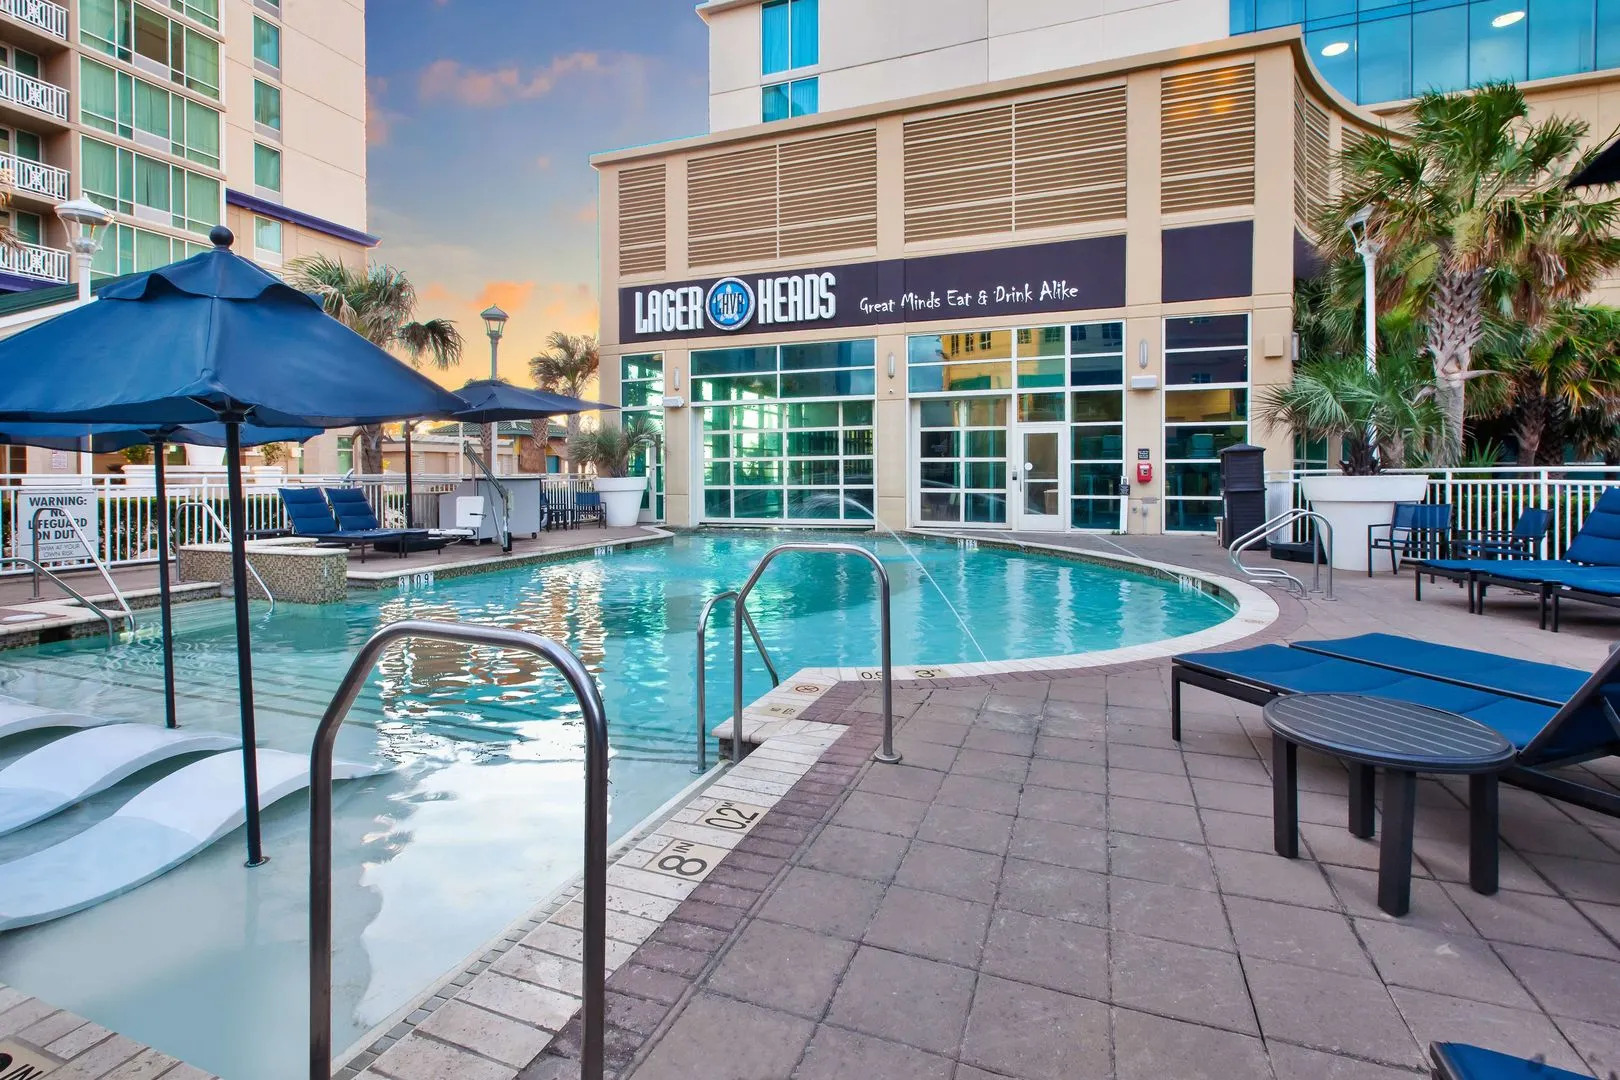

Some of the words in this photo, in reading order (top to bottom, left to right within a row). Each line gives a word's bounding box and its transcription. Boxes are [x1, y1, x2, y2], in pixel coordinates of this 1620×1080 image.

[634, 286, 705, 334] LAGER
[757, 272, 836, 324] HEADS
[859, 297, 896, 315] Great
[901, 292, 941, 311] Minds
[947, 289, 972, 307] Eat
[977, 290, 988, 306] &
[993, 283, 1033, 303] Drink
[1039, 280, 1079, 301] Alike
[29, 496, 87, 506] WARNING:
[28, 518, 88, 530] LFEGUARD
[55, 529, 83, 539] DUT
